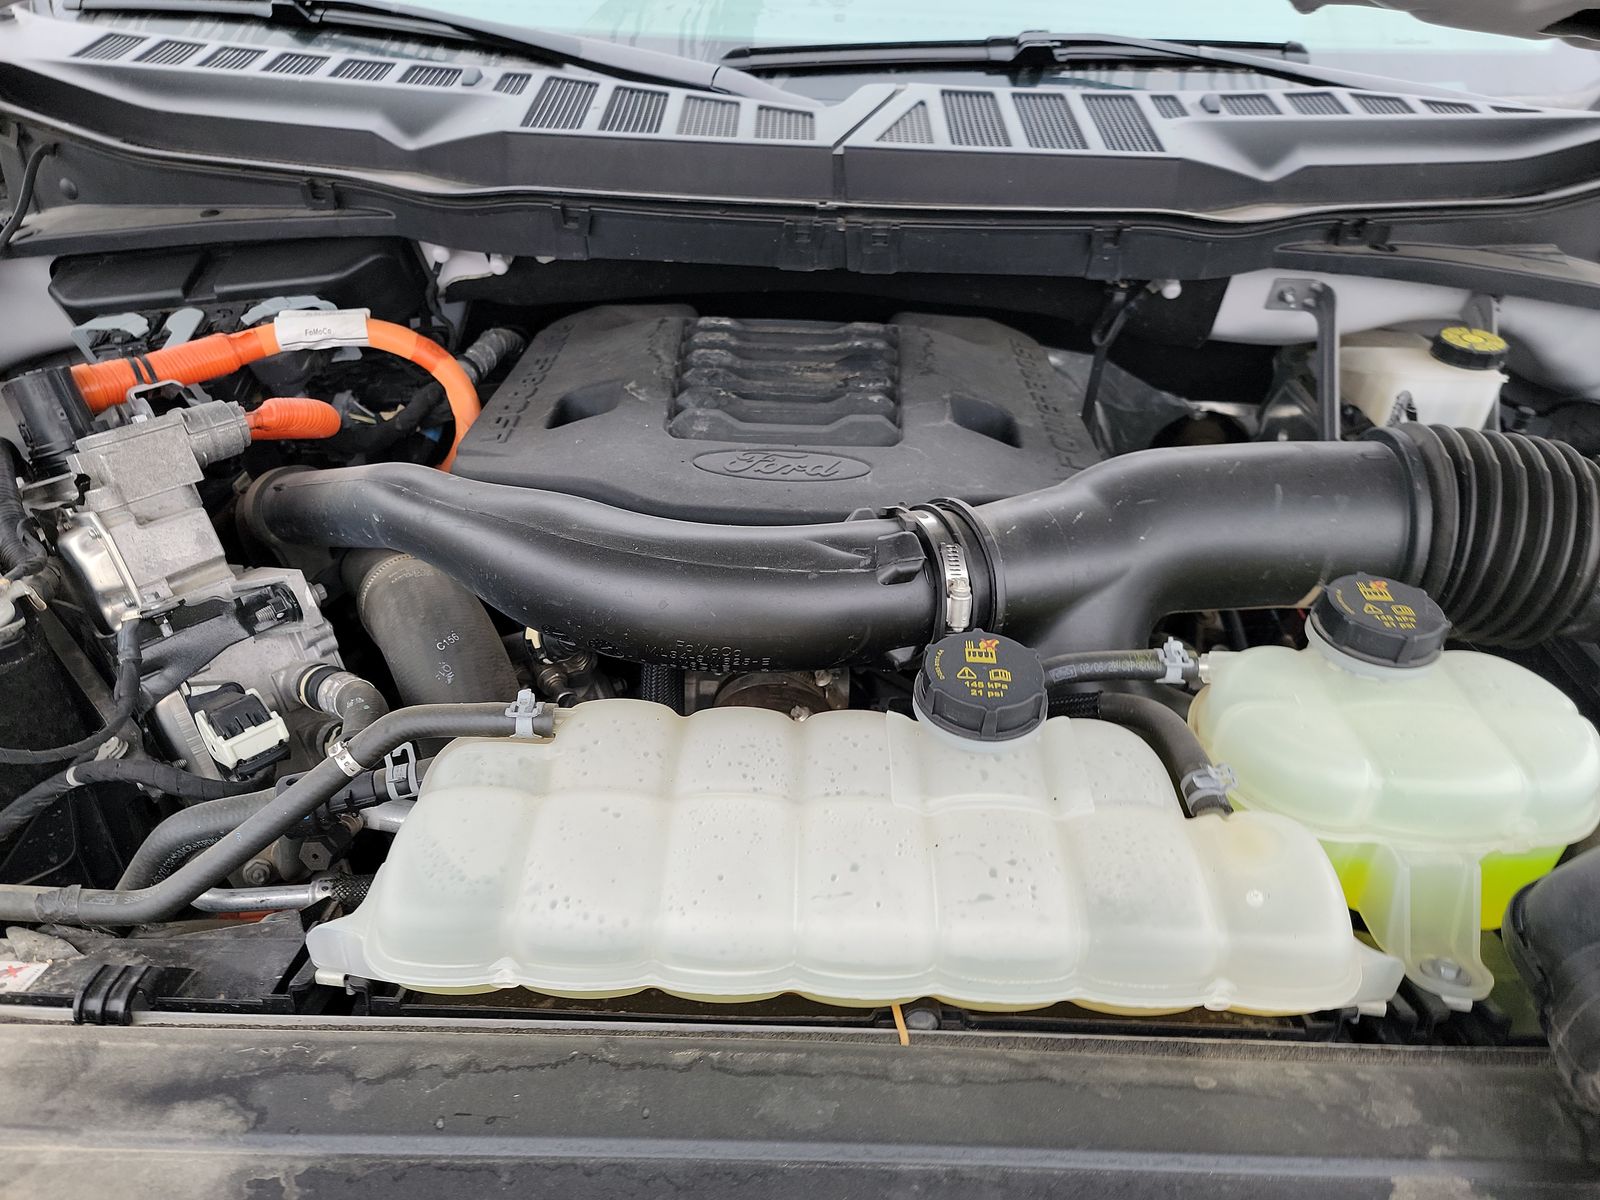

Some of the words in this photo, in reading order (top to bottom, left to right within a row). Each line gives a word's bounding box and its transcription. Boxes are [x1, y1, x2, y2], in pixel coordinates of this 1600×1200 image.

[304, 327, 332, 337] FoMoCo
[723, 451, 840, 477] Ford
[964, 681, 984, 689] 145
[987, 681, 1009, 690] kPa
[987, 690, 1004, 698] psi
